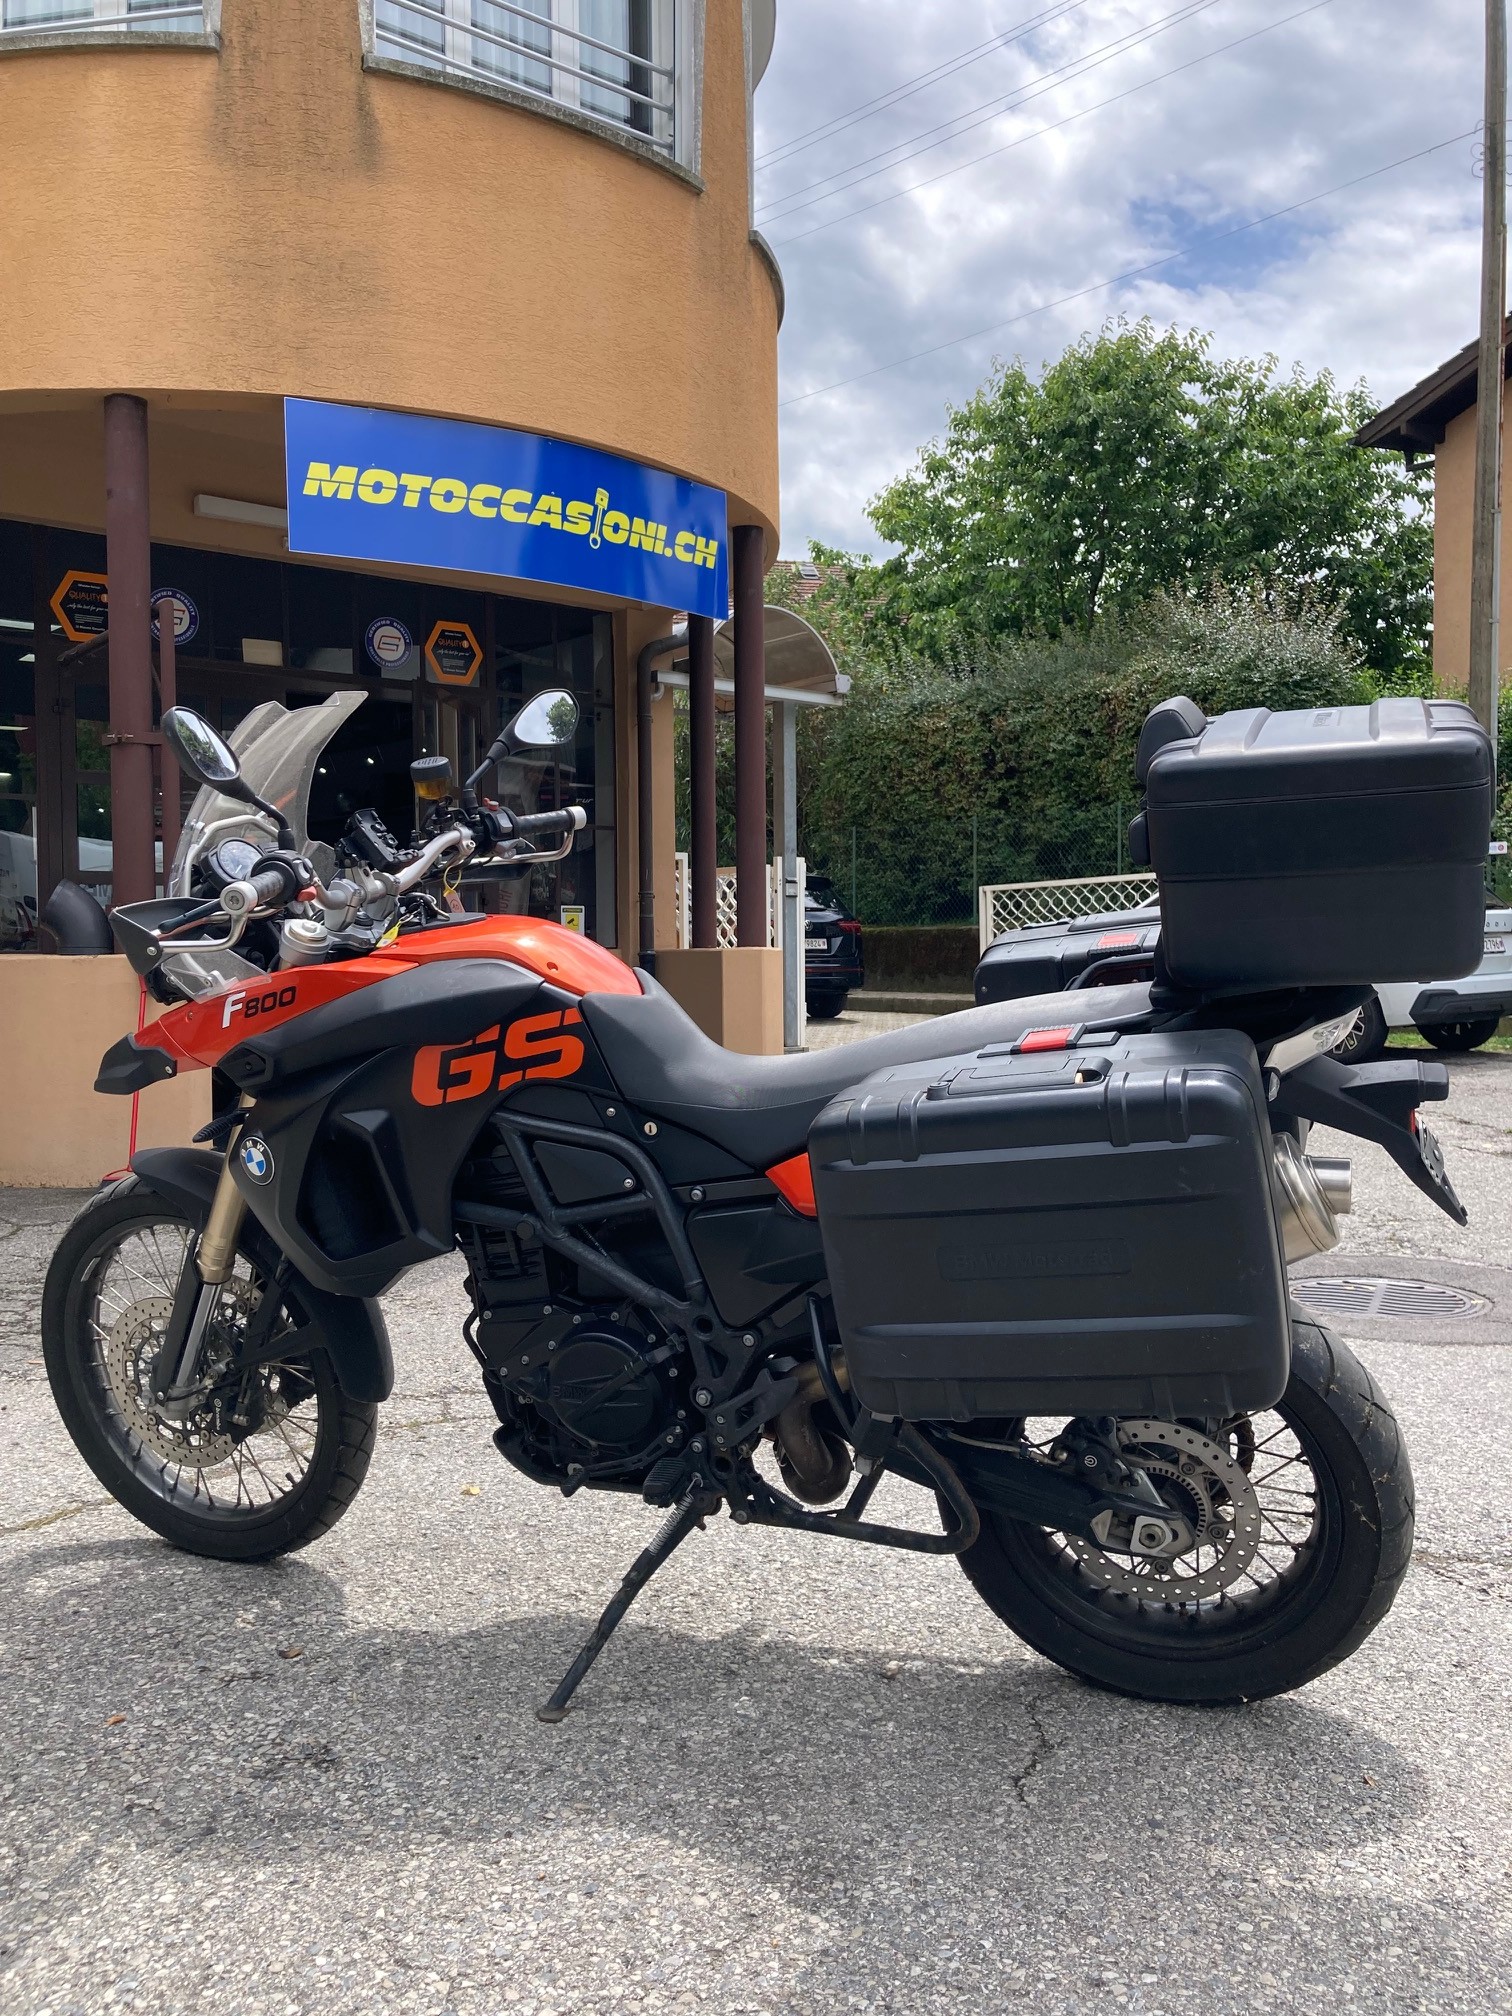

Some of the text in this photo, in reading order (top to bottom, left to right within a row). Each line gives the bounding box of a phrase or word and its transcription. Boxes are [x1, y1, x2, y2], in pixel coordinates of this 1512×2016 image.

[176, 593, 196, 616] QUALITY
[393, 621, 410, 643] QUALITY
[221, 986, 297, 1029] F800
[410, 1007, 585, 1107] GS
[241, 1139, 266, 1158] BMW
